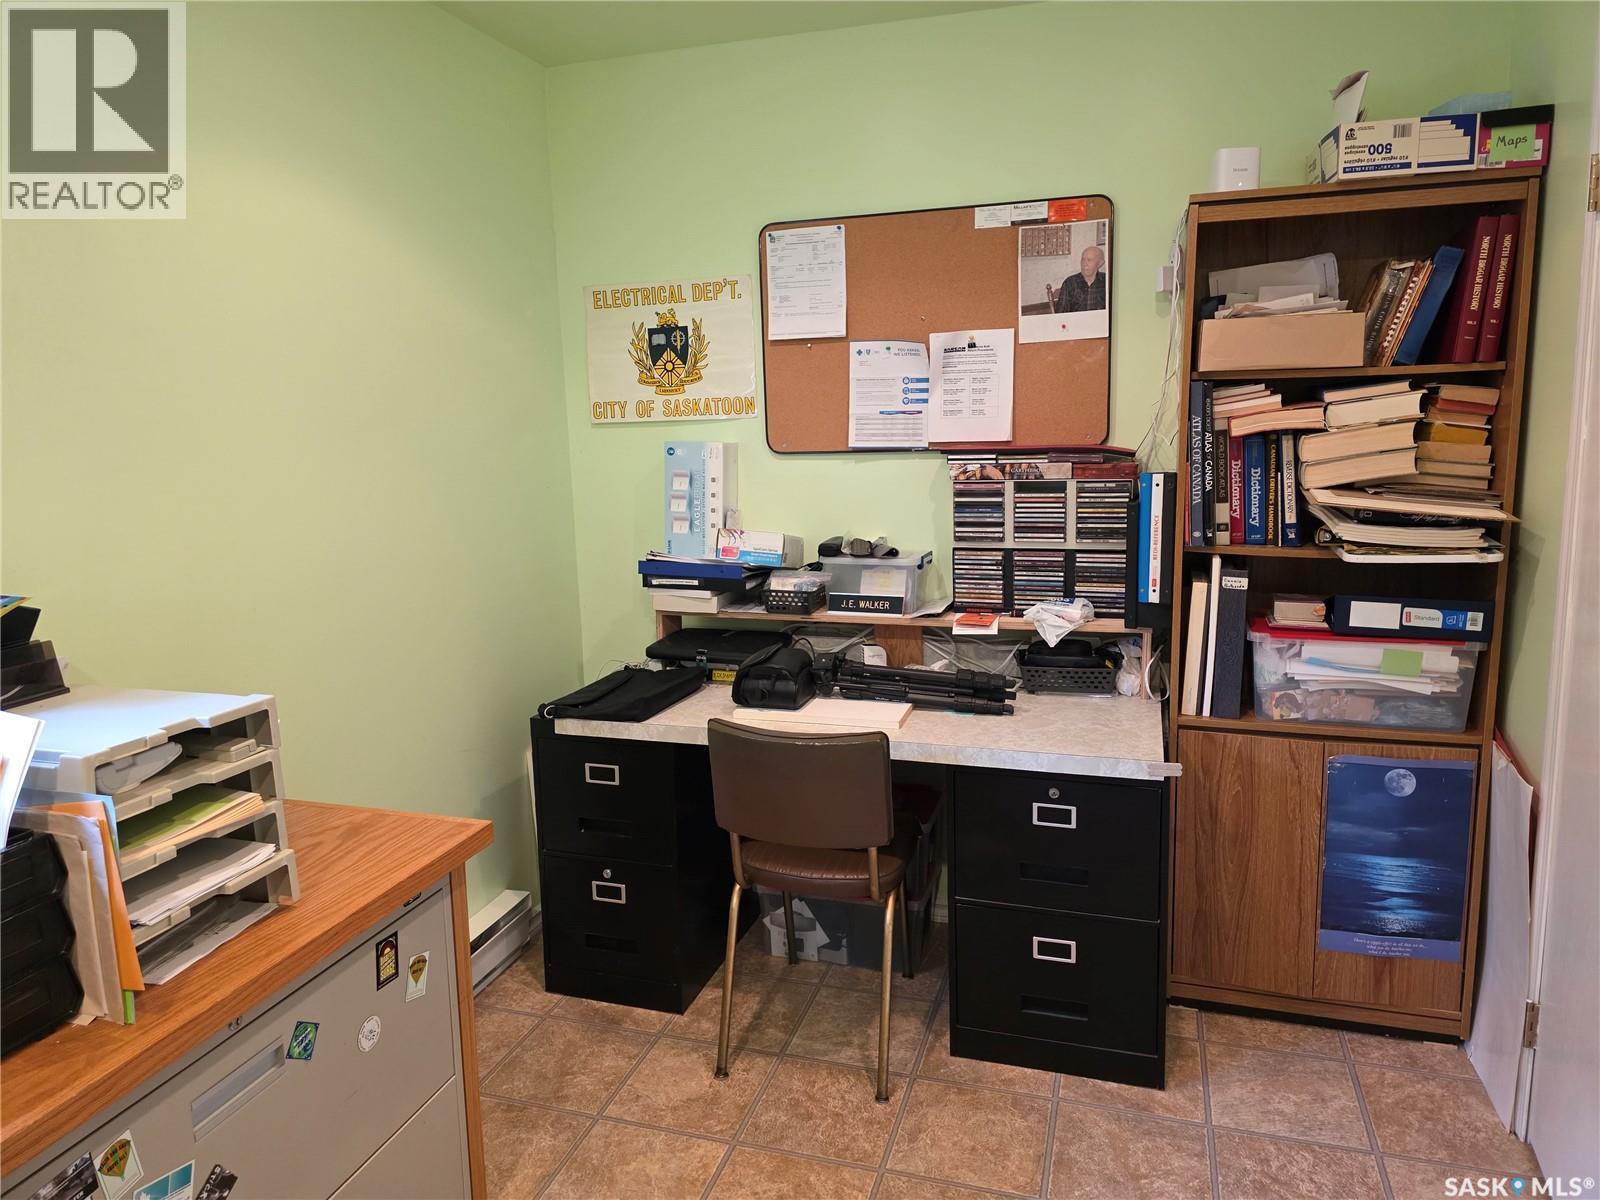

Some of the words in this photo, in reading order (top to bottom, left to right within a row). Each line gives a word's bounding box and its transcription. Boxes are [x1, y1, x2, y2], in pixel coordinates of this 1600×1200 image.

[1368, 143, 1392, 155] 500
[1496, 136, 1528, 149] Maps
[1480, 236, 1491, 258] NORTH
[1501, 234, 1512, 257] NORTH
[1475, 259, 1487, 283] BIGGAR
[1497, 257, 1508, 282] BIGGAR
[592, 284, 686, 310] ELECTRICAL
[692, 278, 742, 302] DEP'T.
[1470, 284, 1482, 311] HISTORY
[1492, 282, 1504, 310] HISTORY
[593, 401, 627, 419] CITY
[636, 400, 654, 418] OF
[663, 396, 756, 418] SASKATOON
[1192, 415, 1202, 447] ATLAS
[1192, 449, 1202, 462] OF
[1192, 465, 1202, 504] CANADA
[1230, 460, 1241, 519] Dictionary
[1249, 467, 1261, 527] Dictionary
[859, 600, 890, 610] WALKER
